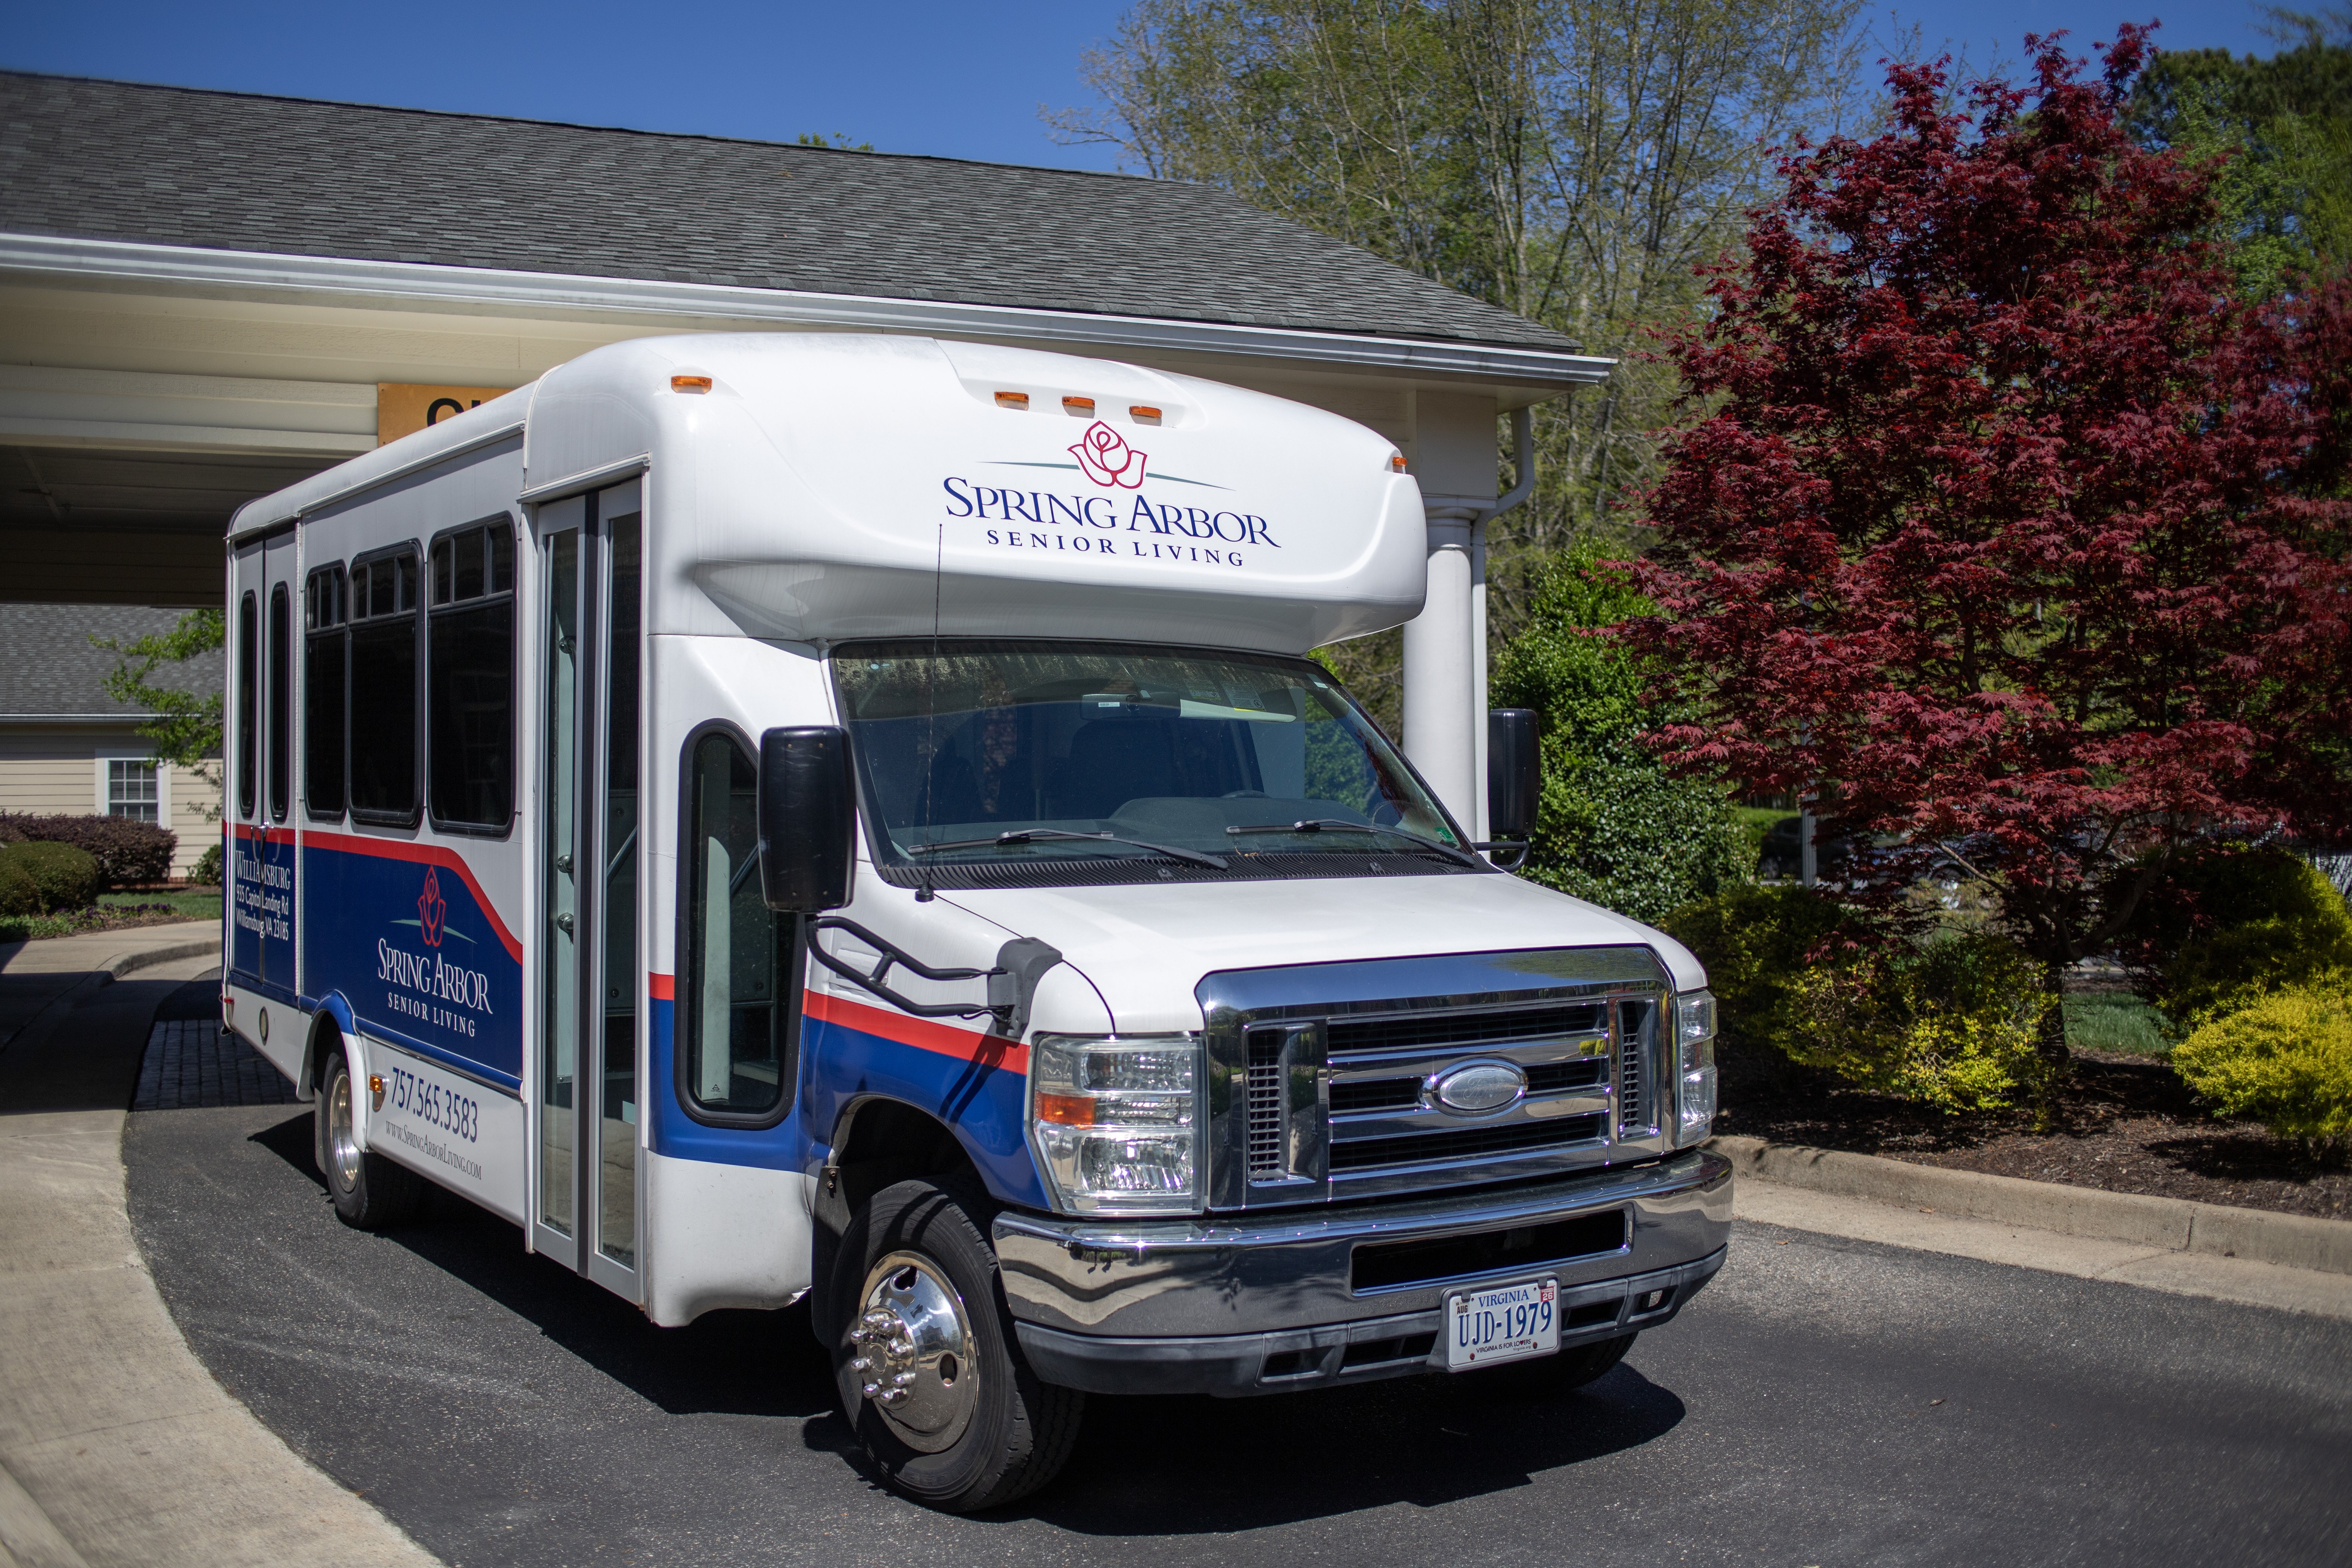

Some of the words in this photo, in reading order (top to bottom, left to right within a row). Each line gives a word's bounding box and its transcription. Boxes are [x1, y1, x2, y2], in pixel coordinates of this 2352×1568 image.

[943, 477, 1117, 529] SPRING
[1126, 495, 1281, 547] ARBOR
[988, 530, 1116, 554] SENIOR
[1134, 542, 1243, 567] LIVING
[236, 850, 290, 890] WILLIAMSBURG
[245, 887, 261, 911] Capitol
[262, 891, 280, 919] Landing
[282, 895, 288, 915] Rd
[265, 916, 273, 936] VA
[273, 918, 288, 941] 23185
[378, 938, 430, 993] SPRING
[432, 953, 493, 1014] ARBOR
[388, 992, 428, 1021] SENIOR
[433, 1007, 476, 1037] LIVING
[392, 1067, 478, 1143] 757.565.3583
[1457, 1305, 1468, 1315] AUG
[1478, 1289, 1530, 1308] VIRGINIA
[1543, 1292, 1553, 1300] 26
[1458, 1301, 1551, 1347] UJD-1979
